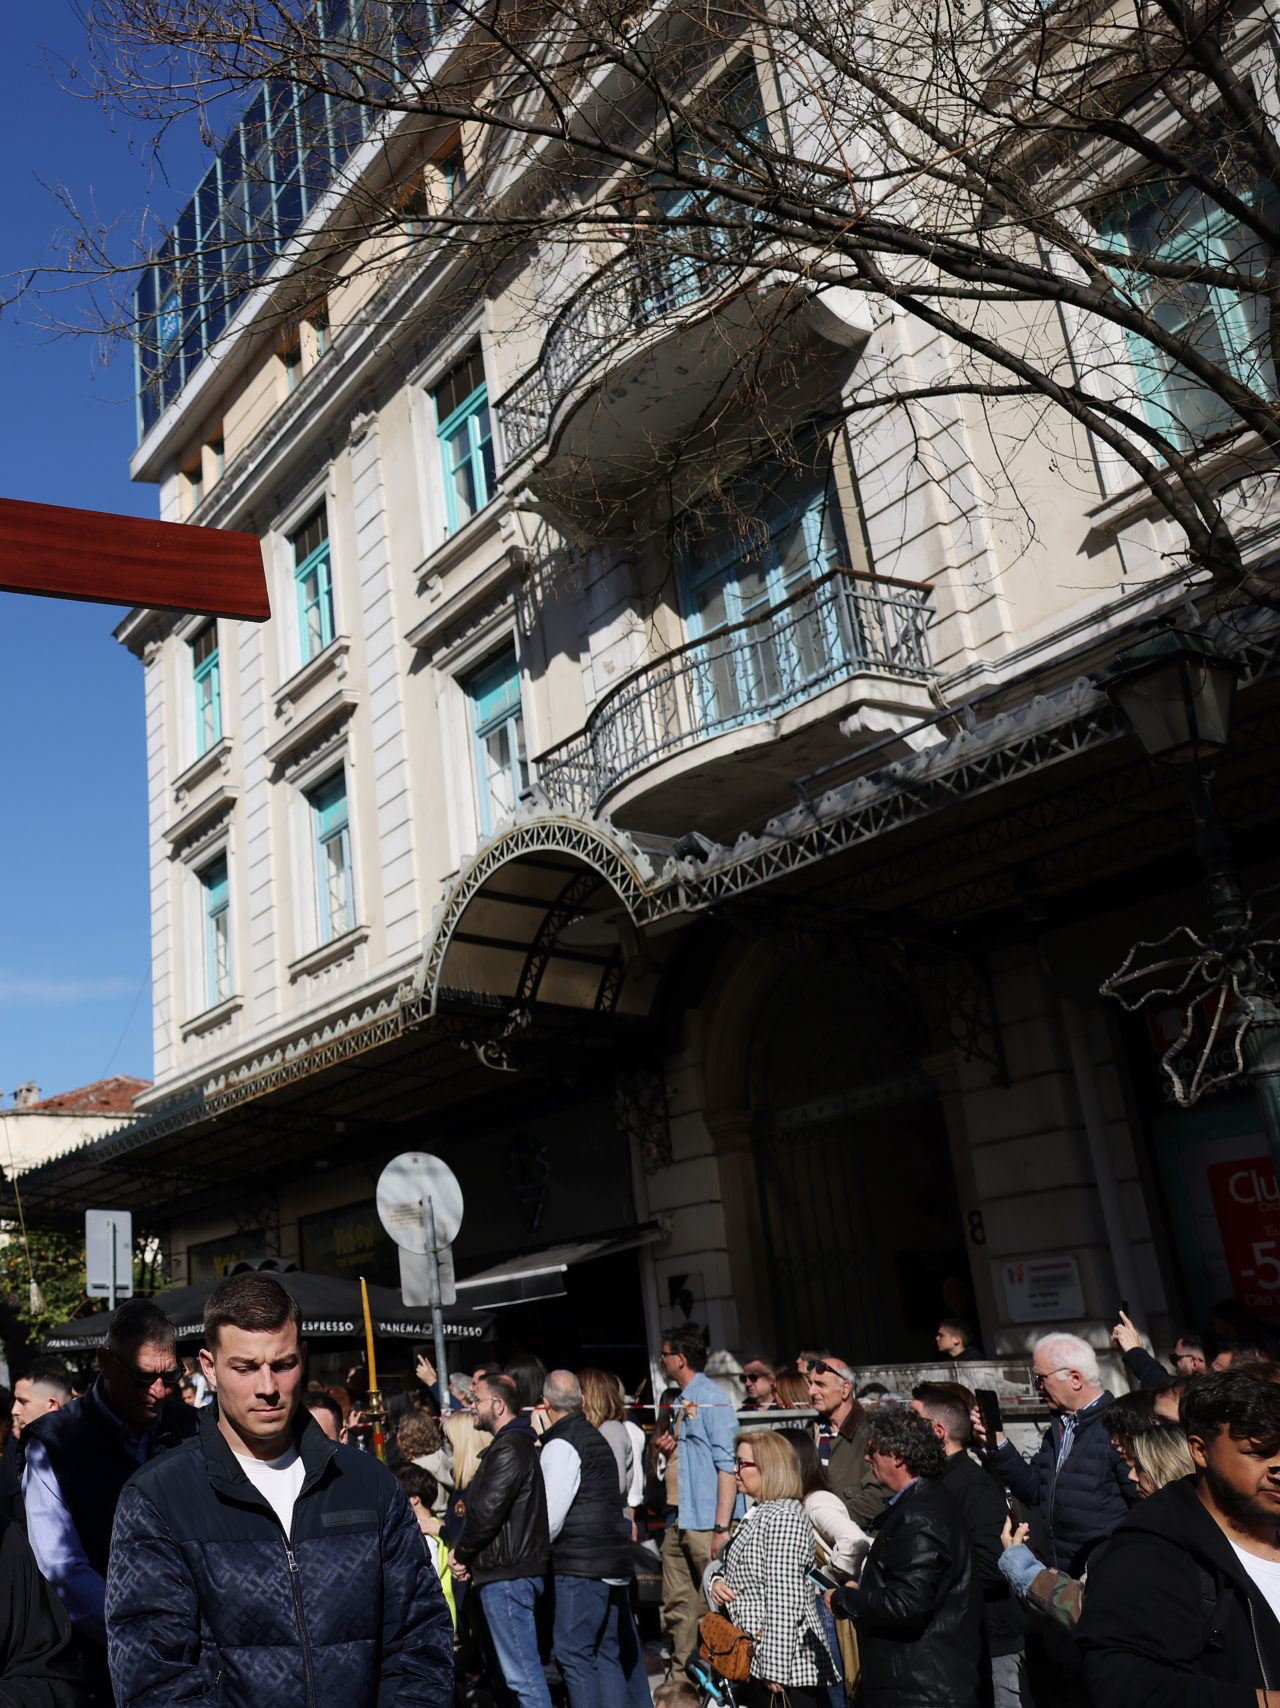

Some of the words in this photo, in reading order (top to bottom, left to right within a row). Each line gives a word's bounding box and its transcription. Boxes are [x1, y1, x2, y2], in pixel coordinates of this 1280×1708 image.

[968, 1210, 985, 1245] 8
[1240, 1239, 1280, 1290] -5
[302, 1320, 354, 1331] ESPRESSO
[442, 1324, 483, 1337] SPRESSO
